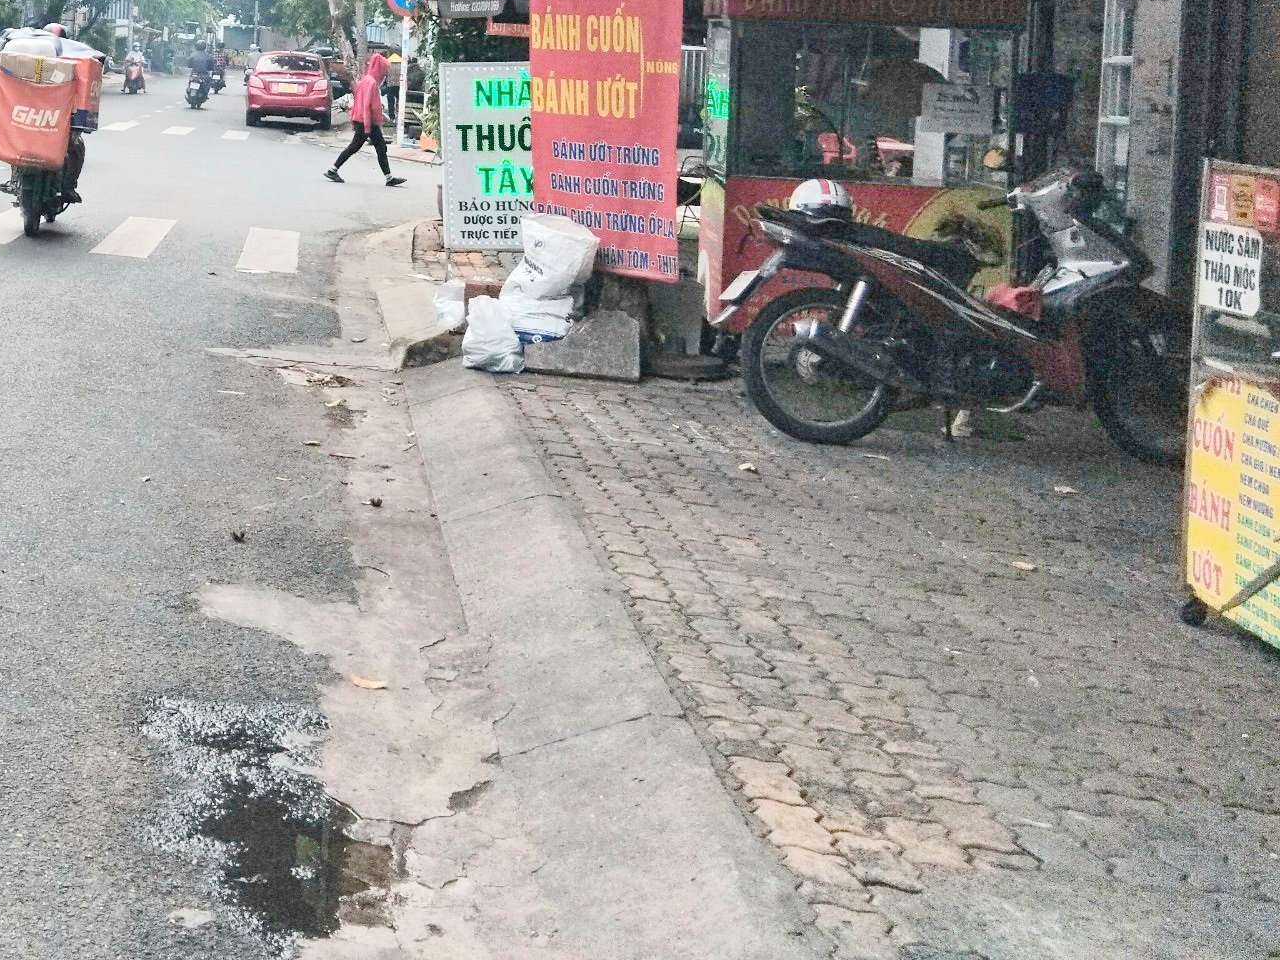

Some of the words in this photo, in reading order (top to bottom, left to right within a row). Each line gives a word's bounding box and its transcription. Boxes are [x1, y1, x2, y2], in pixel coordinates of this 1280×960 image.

[531, 5, 581, 52] BÁNH
[586, 2, 640, 54] CUỐN
[645, 57, 679, 74] NÓNG
[474, 70, 531, 108] NHÀ
[532, 69, 589, 116] BÁNH
[596, 73, 639, 119] ƯỚT
[11, 105, 60, 127] GHN
[552, 138, 585, 161] BÁNH
[589, 139, 613, 163] ƯỚT
[615, 142, 660, 167] TRỨNG
[477, 158, 533, 196] TÂY
[551, 171, 581, 194] BÁNH
[584, 171, 619, 197] CUỐN
[622, 177, 664, 202] TRỨNG
[458, 197, 491, 211] BẢO
[570, 203, 602, 229] CUỐN
[606, 209, 645, 235] TRỨNG
[460, 229, 490, 241] TRỰC
[493, 227, 518, 239] TIẾP
[463, 215, 493, 227] DƯỢC
[497, 214, 507, 225] SĨ
[1205, 228, 1234, 255] NƯỚC
[627, 248, 650, 270] TÔM
[1204, 255, 1231, 285] THẢO
[1233, 263, 1256, 295] MỘC
[1218, 287, 1242, 311] 10K
[1193, 413, 1236, 463] CUỐN
[1189, 478, 1232, 533] BÁNH
[1192, 549, 1222, 597] ƯỚT
